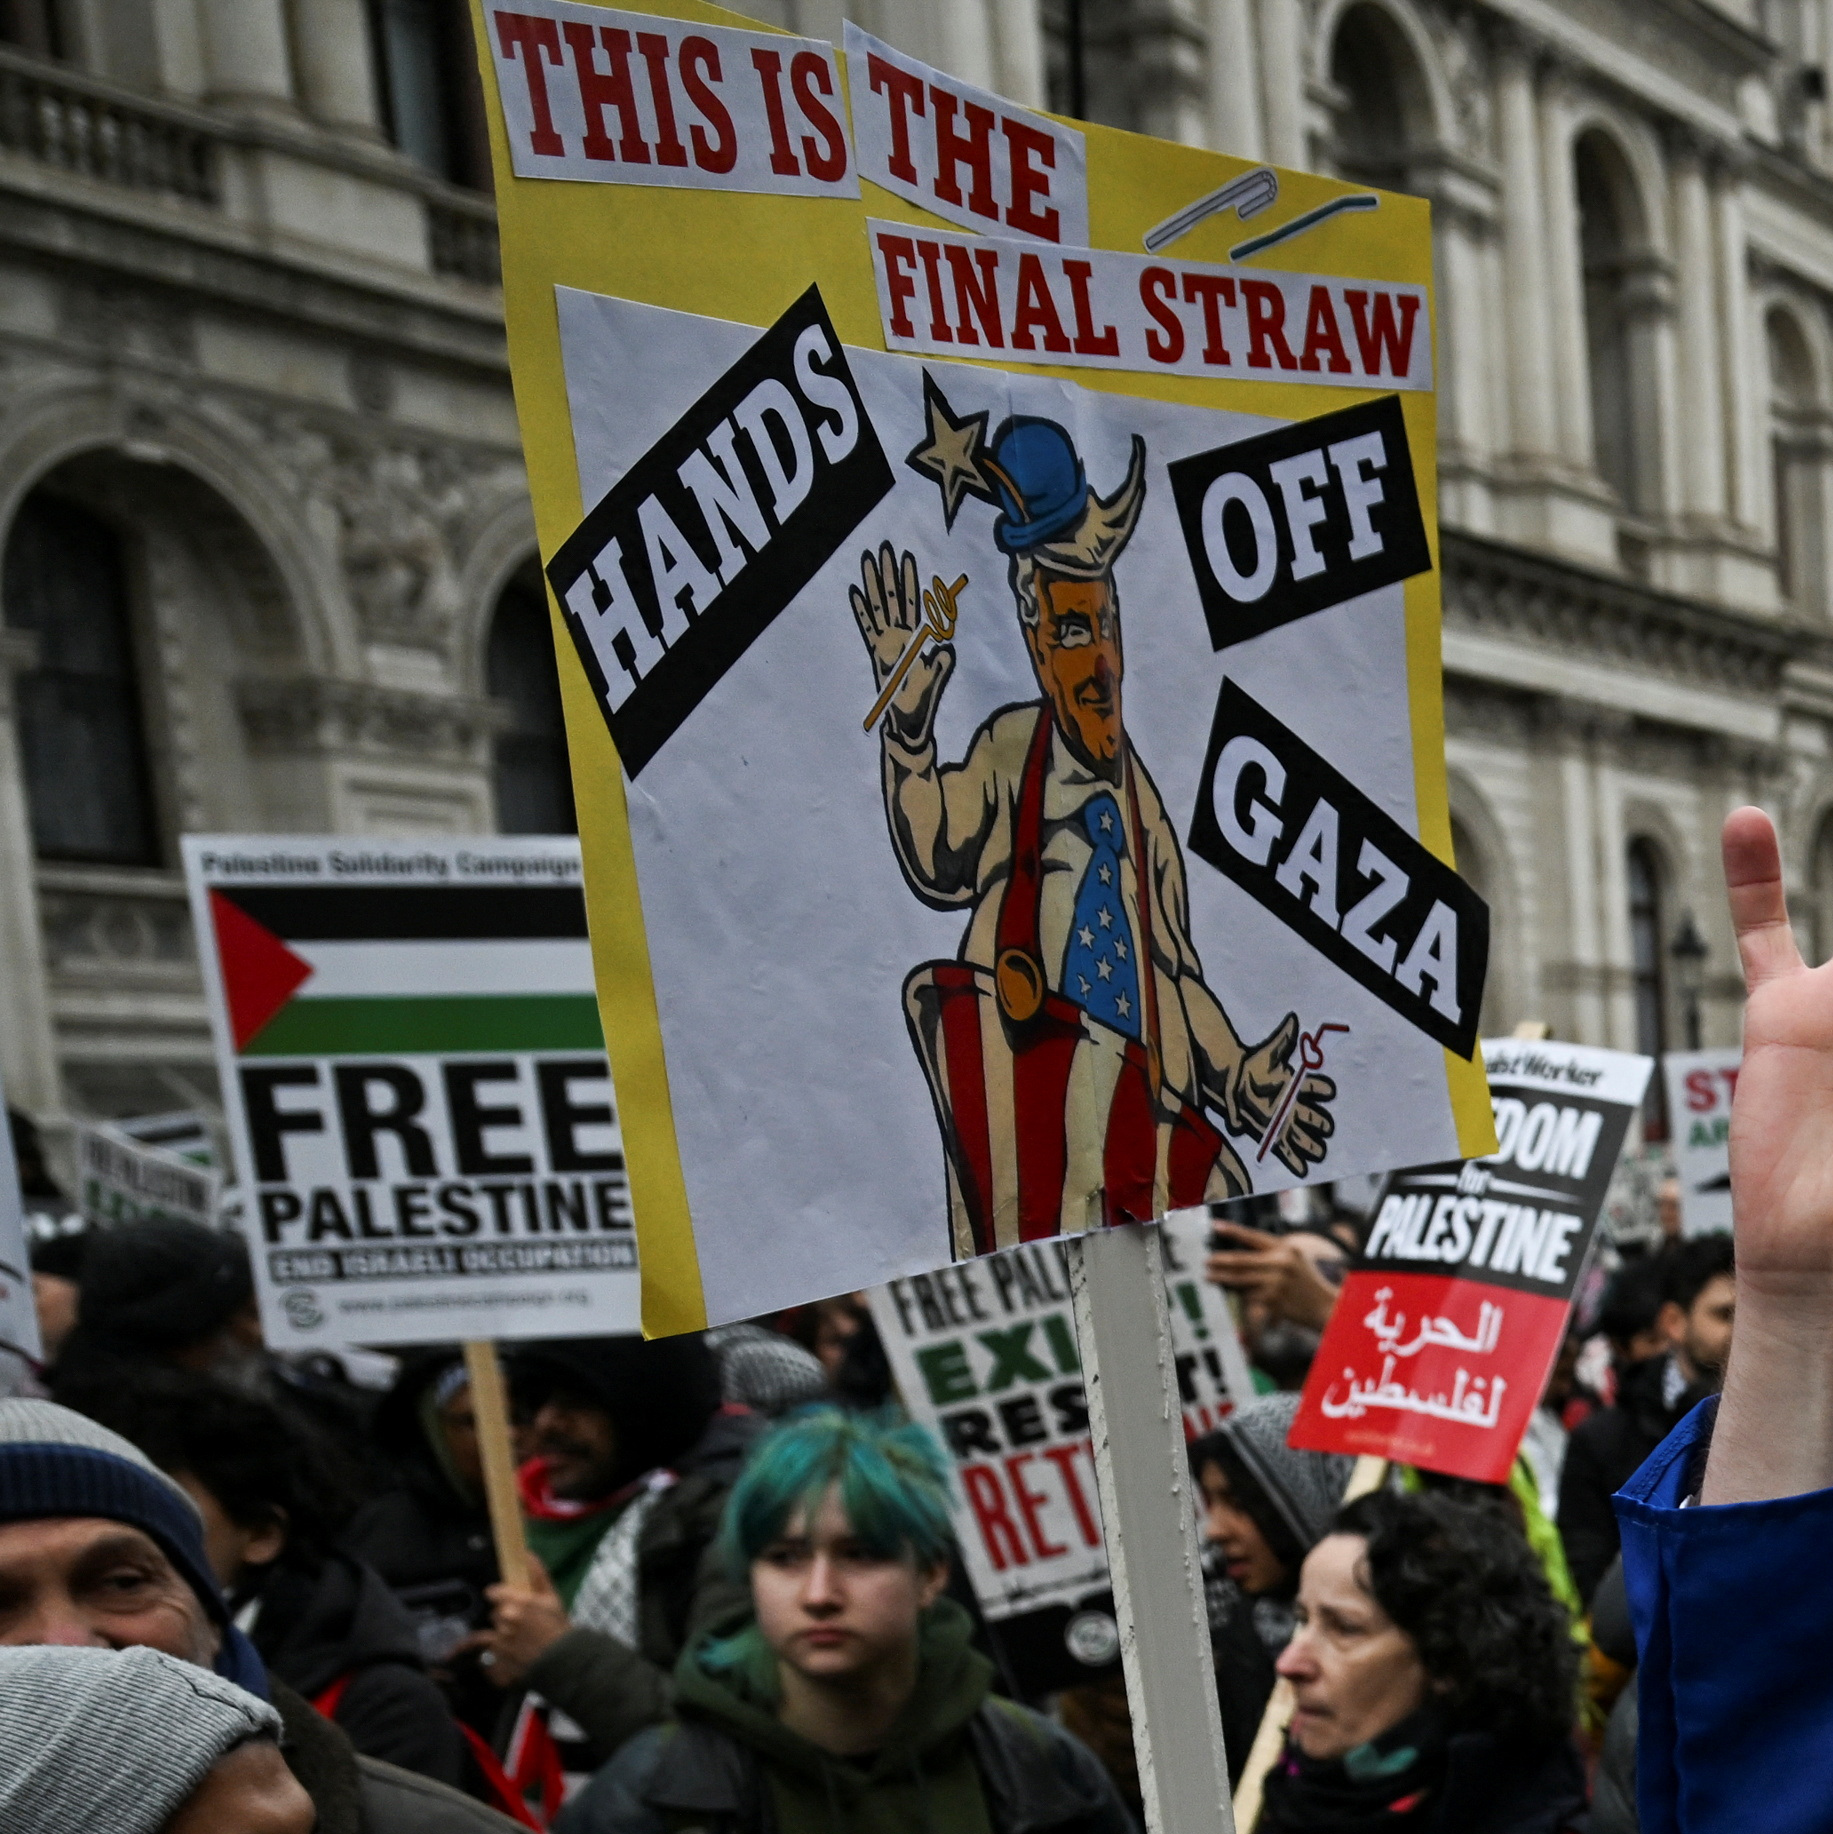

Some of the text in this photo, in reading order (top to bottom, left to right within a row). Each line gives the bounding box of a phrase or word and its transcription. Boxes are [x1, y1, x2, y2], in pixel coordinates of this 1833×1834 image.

[496, 10, 1062, 246] THIS IS THE
[877, 231, 1420, 379] FINAL STRAW
[562, 322, 862, 718] HANDS
[1199, 430, 1390, 603] OFF
[202, 850, 322, 876] Palestine
[328, 850, 450, 884] Solidarity
[1212, 734, 1465, 1025] GAZA
[239, 1060, 626, 1183] FREE
[1492, 1096, 1604, 1181] DOM
[260, 1181, 634, 1244] PALESTINE
[1365, 1193, 1583, 1285] PALESTINE
[887, 1258, 990, 1337] FREE
[1364, 1286, 1504, 1356] الحرية
[1321, 1355, 1507, 1429] لفلسطين
